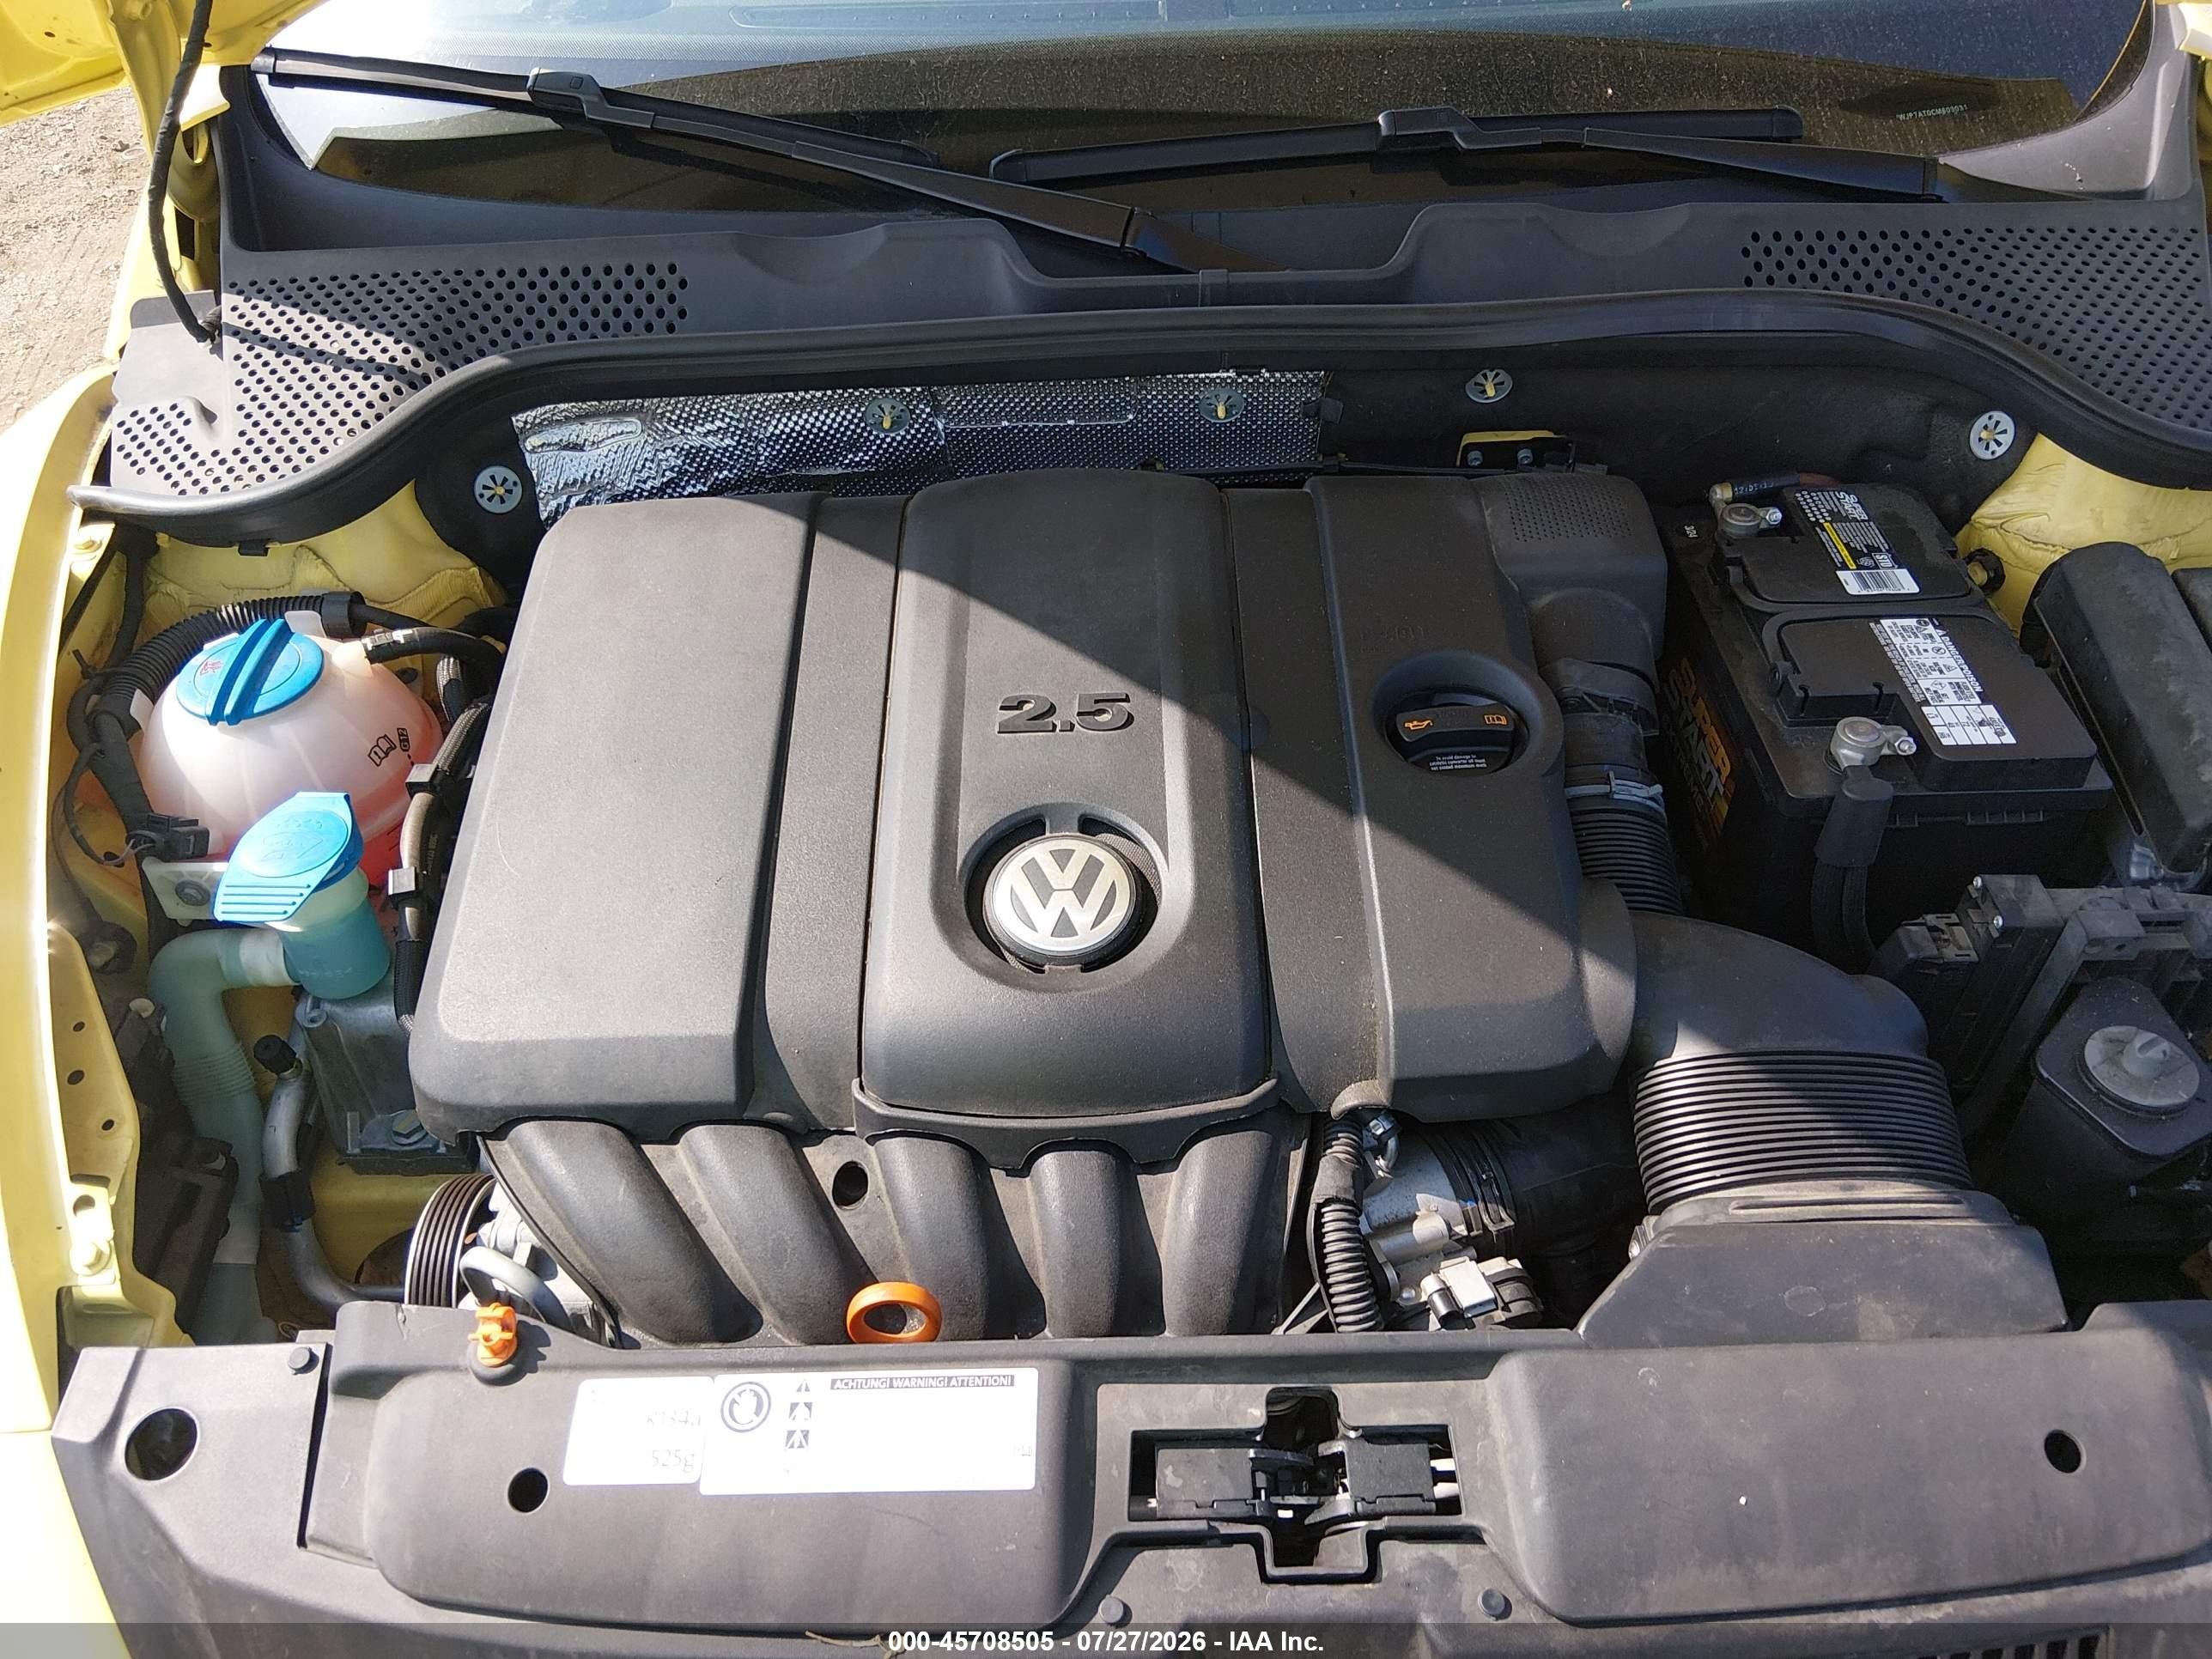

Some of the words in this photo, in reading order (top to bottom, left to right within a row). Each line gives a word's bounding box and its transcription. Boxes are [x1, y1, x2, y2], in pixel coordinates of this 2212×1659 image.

[1875, 554, 1893, 568] STD
[997, 692, 1134, 735] 2.5
[398, 728, 410, 750] G12
[834, 1376, 890, 1389] ACHTUNG!
[892, 1375, 948, 1389] WARNING!
[950, 1375, 1012, 1388] ATTENTION!
[651, 1449, 695, 1474] 525g
